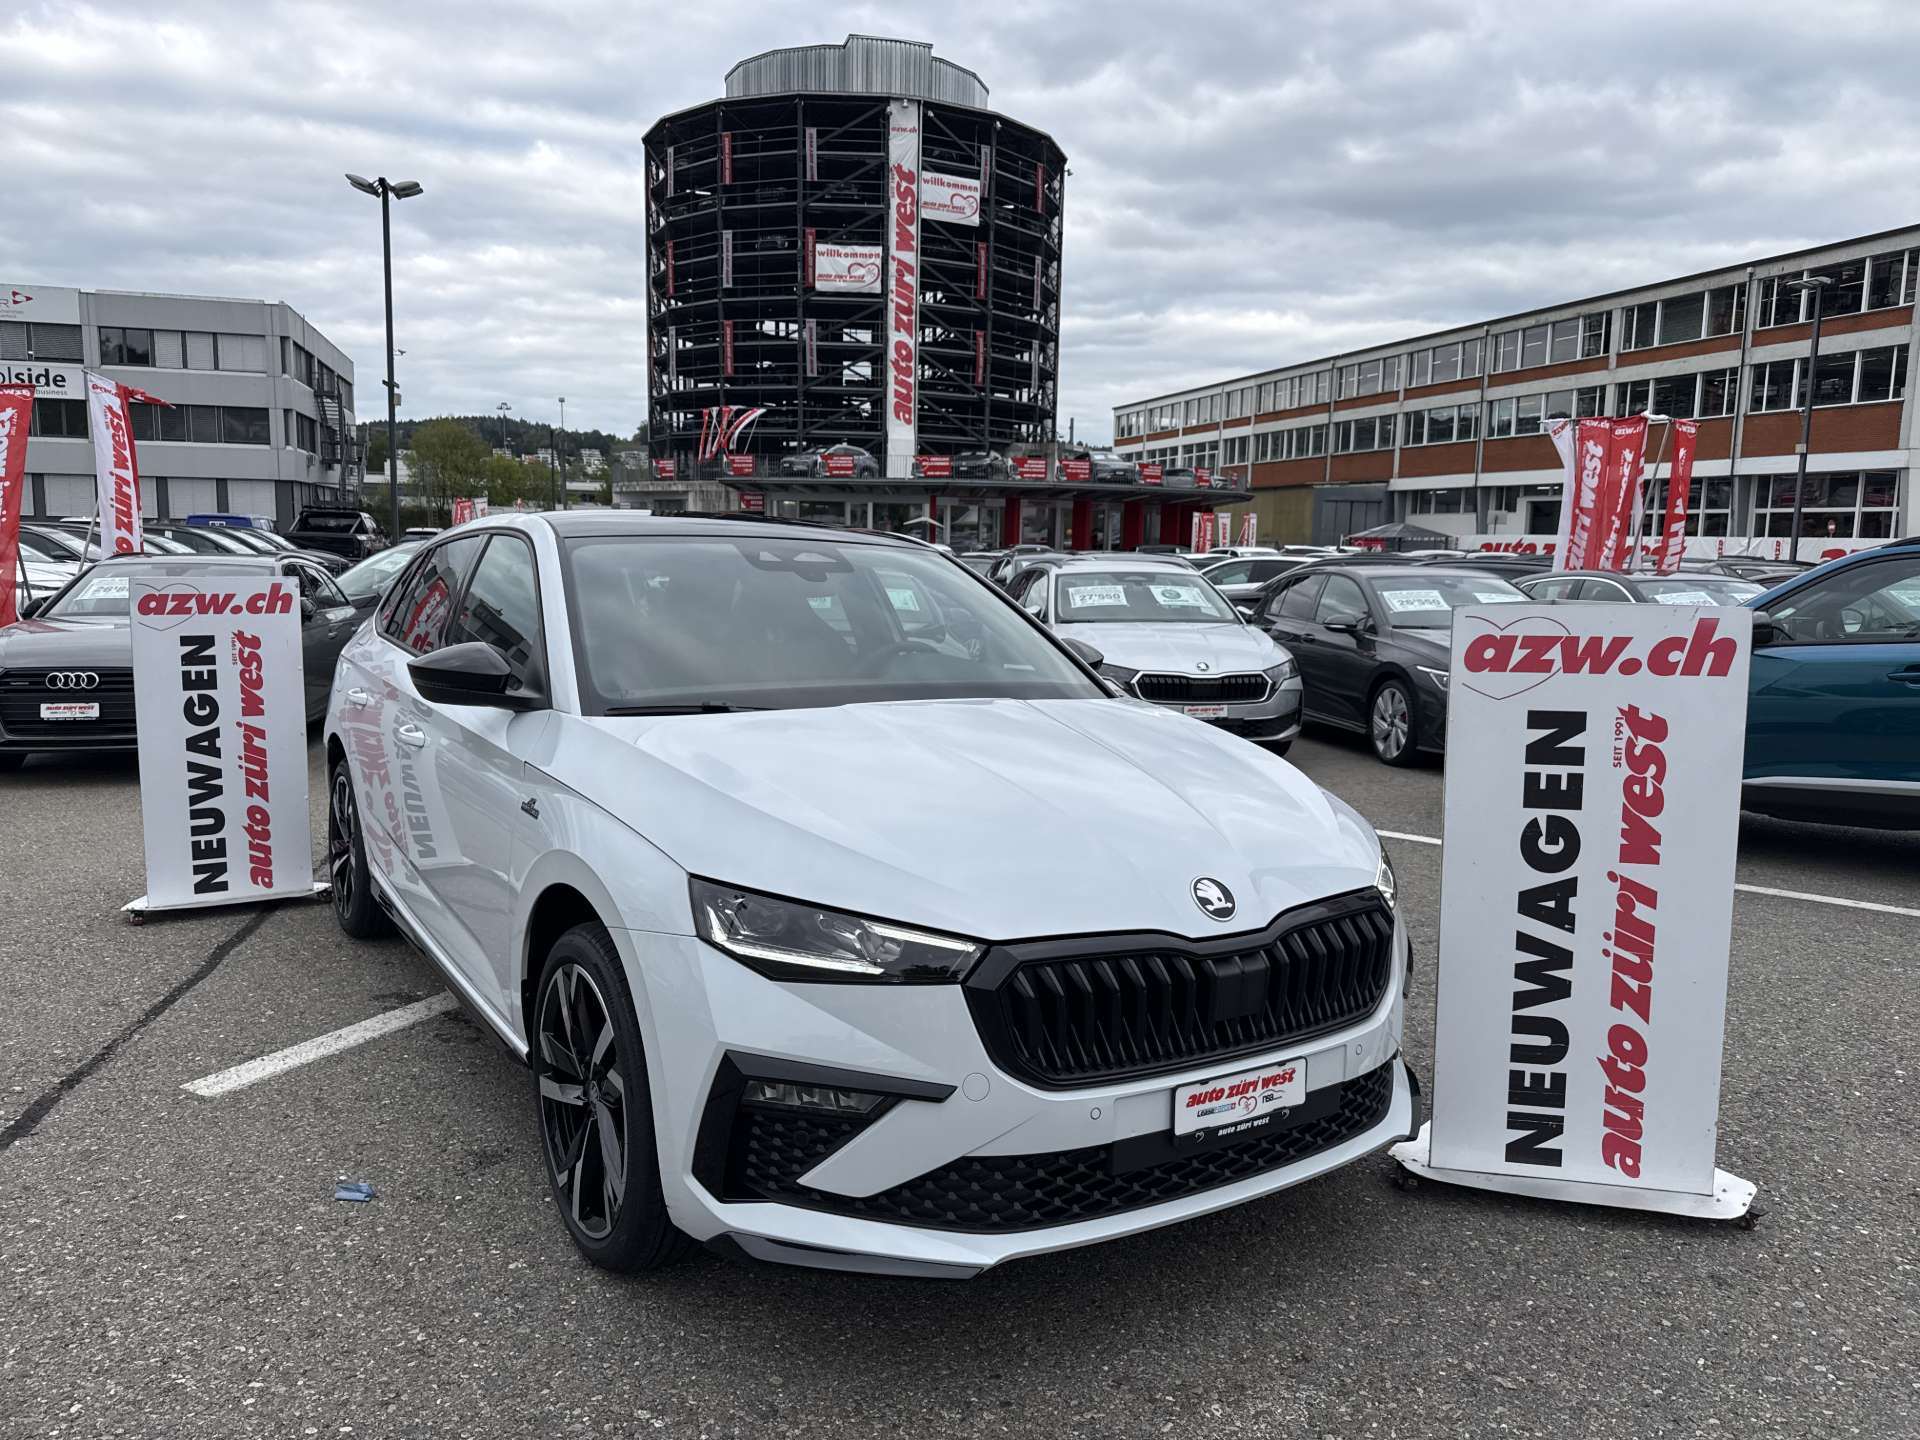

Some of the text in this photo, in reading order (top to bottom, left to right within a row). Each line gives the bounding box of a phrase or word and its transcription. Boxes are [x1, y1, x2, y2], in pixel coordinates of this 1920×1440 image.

[922, 176, 979, 193] willkommen
[817, 248, 880, 259] willkommen
[890, 163, 917, 426] auto züri west
[104, 403, 130, 471] west
[108, 471, 135, 536] züri
[1580, 439, 1604, 509] west
[137, 583, 293, 616] azw.ch
[1464, 617, 1738, 678] azw.ch
[179, 634, 229, 895] NEUWAGEN
[231, 629, 274, 889] auto züri west
[1613, 716, 1625, 768] SEIT 1991
[1504, 709, 1588, 1168] NEUWAGEN
[1595, 703, 1669, 1179] auto züri west
[1186, 1067, 1297, 1108] auto züri west
[1217, 1116, 1270, 1137] auto züri west
